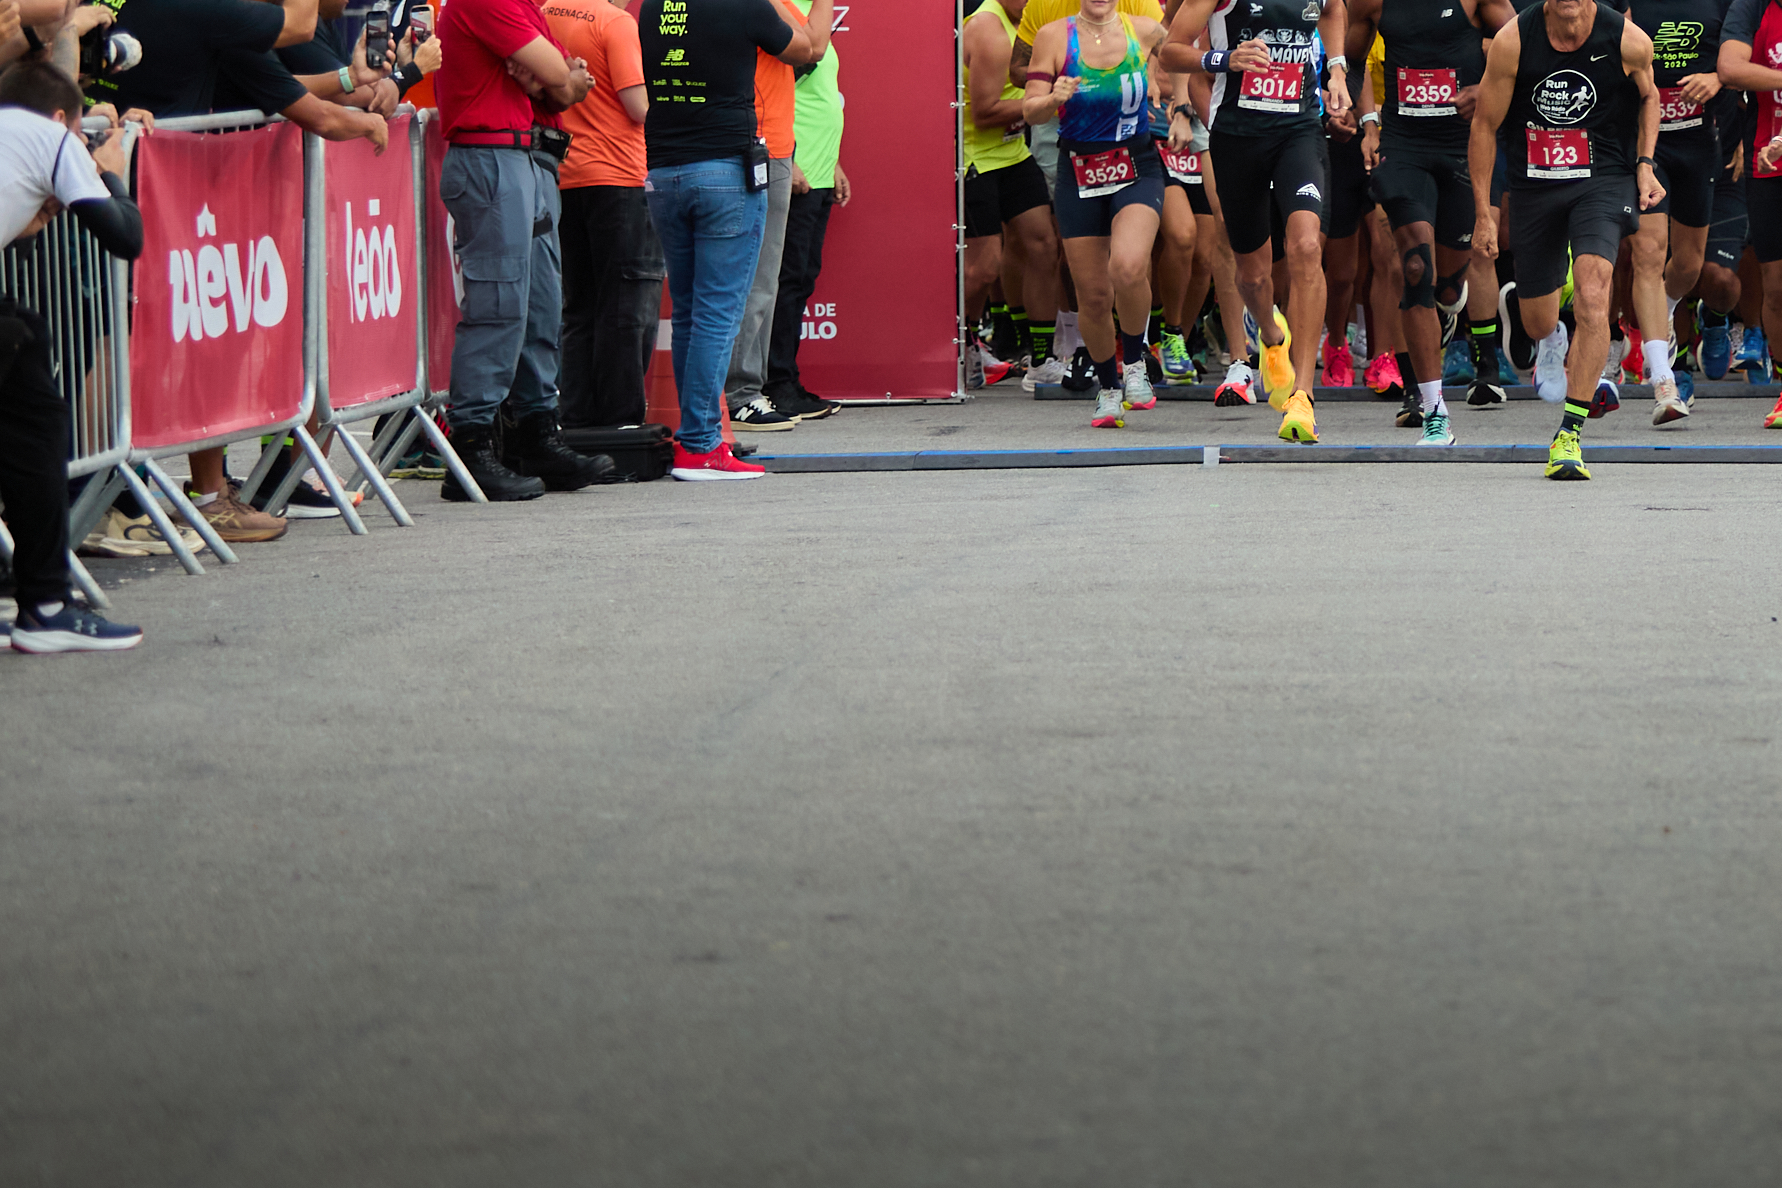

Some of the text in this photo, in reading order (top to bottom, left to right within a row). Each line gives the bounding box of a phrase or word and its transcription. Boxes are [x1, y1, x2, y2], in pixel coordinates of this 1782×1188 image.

[663, 0, 687, 12] Run
[660, 13, 689, 26] your
[659, 25, 689, 37] way.
[1678, 52, 1699, 60] Paulo
[1664, 60, 1687, 69] 2026
[1250, 77, 1298, 98] 3014
[1545, 80, 1568, 89] Run
[1405, 85, 1452, 103] 2359
[1541, 90, 1570, 101] Rock
[1543, 146, 1578, 165] 123
[1085, 163, 1128, 185] 3529
[815, 303, 836, 317] DE
